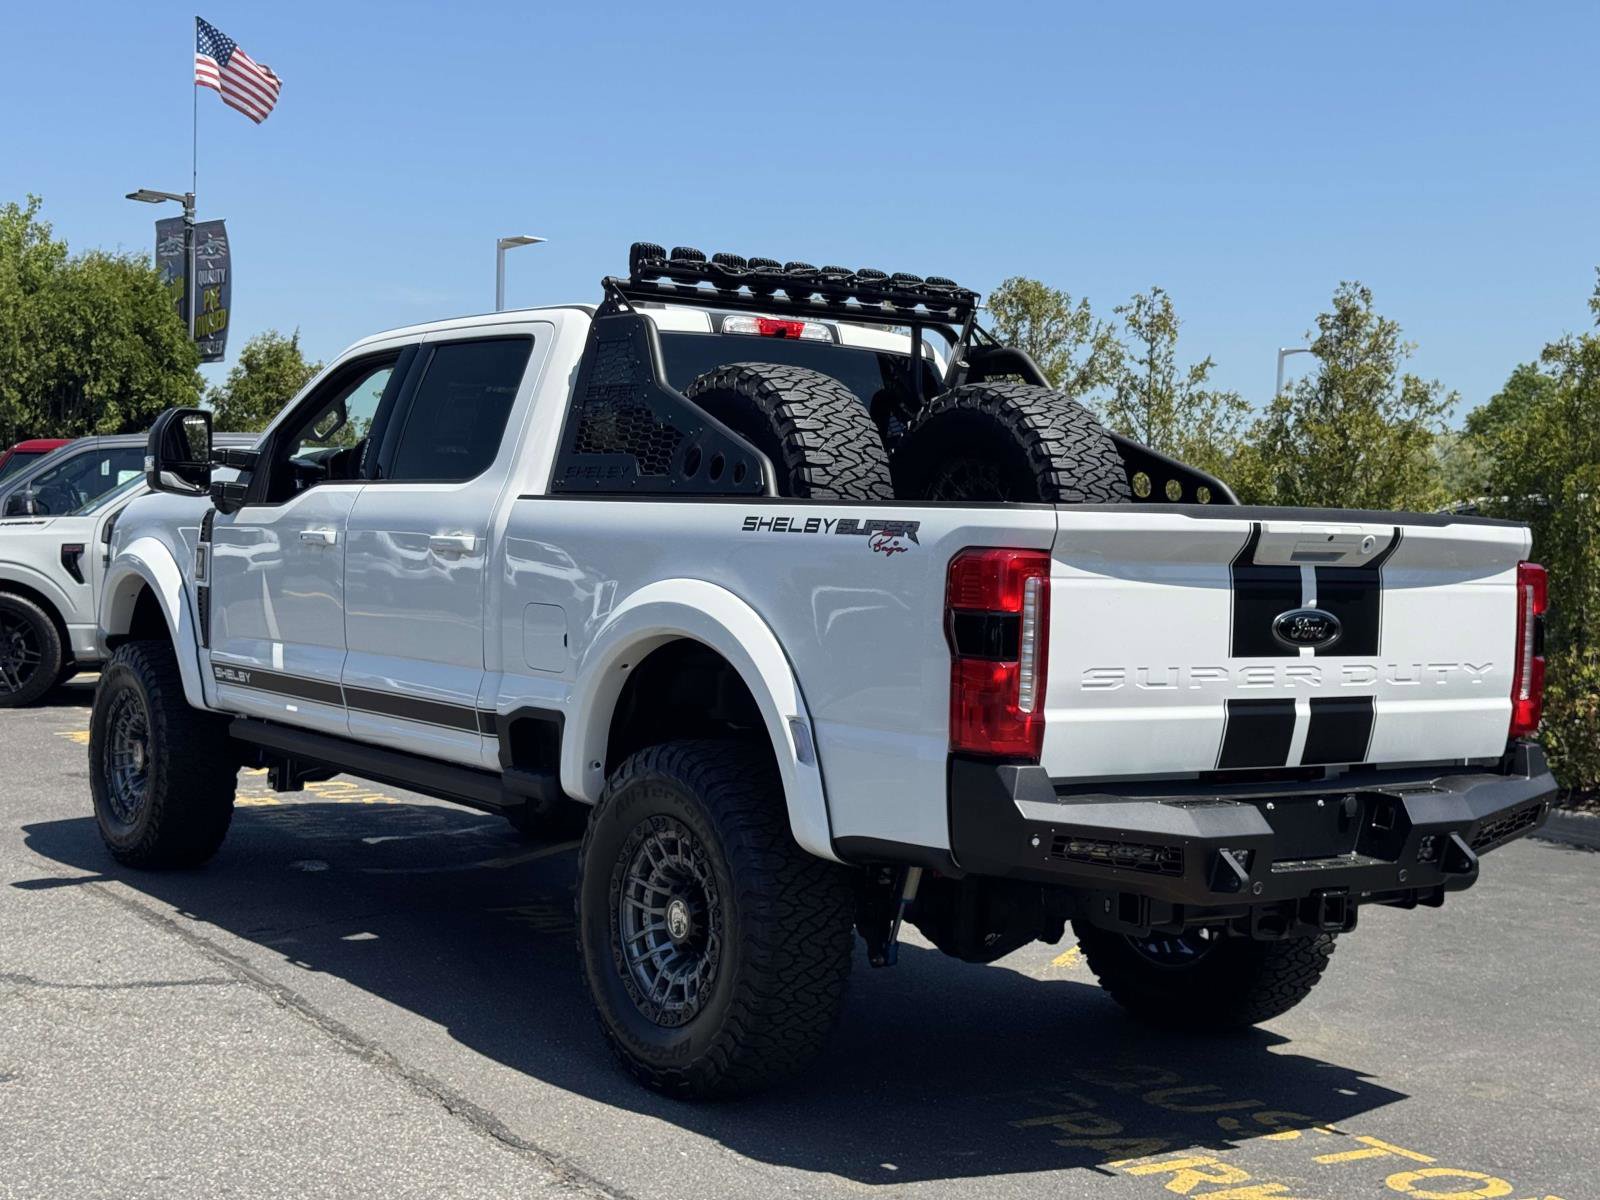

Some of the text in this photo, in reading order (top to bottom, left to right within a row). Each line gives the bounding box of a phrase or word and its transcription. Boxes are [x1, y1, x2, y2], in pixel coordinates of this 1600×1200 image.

[742, 516, 921, 546] SHELBY SUPER
[214, 667, 251, 684] SHELBY
[1080, 662, 1494, 691] SUPER DUTY
